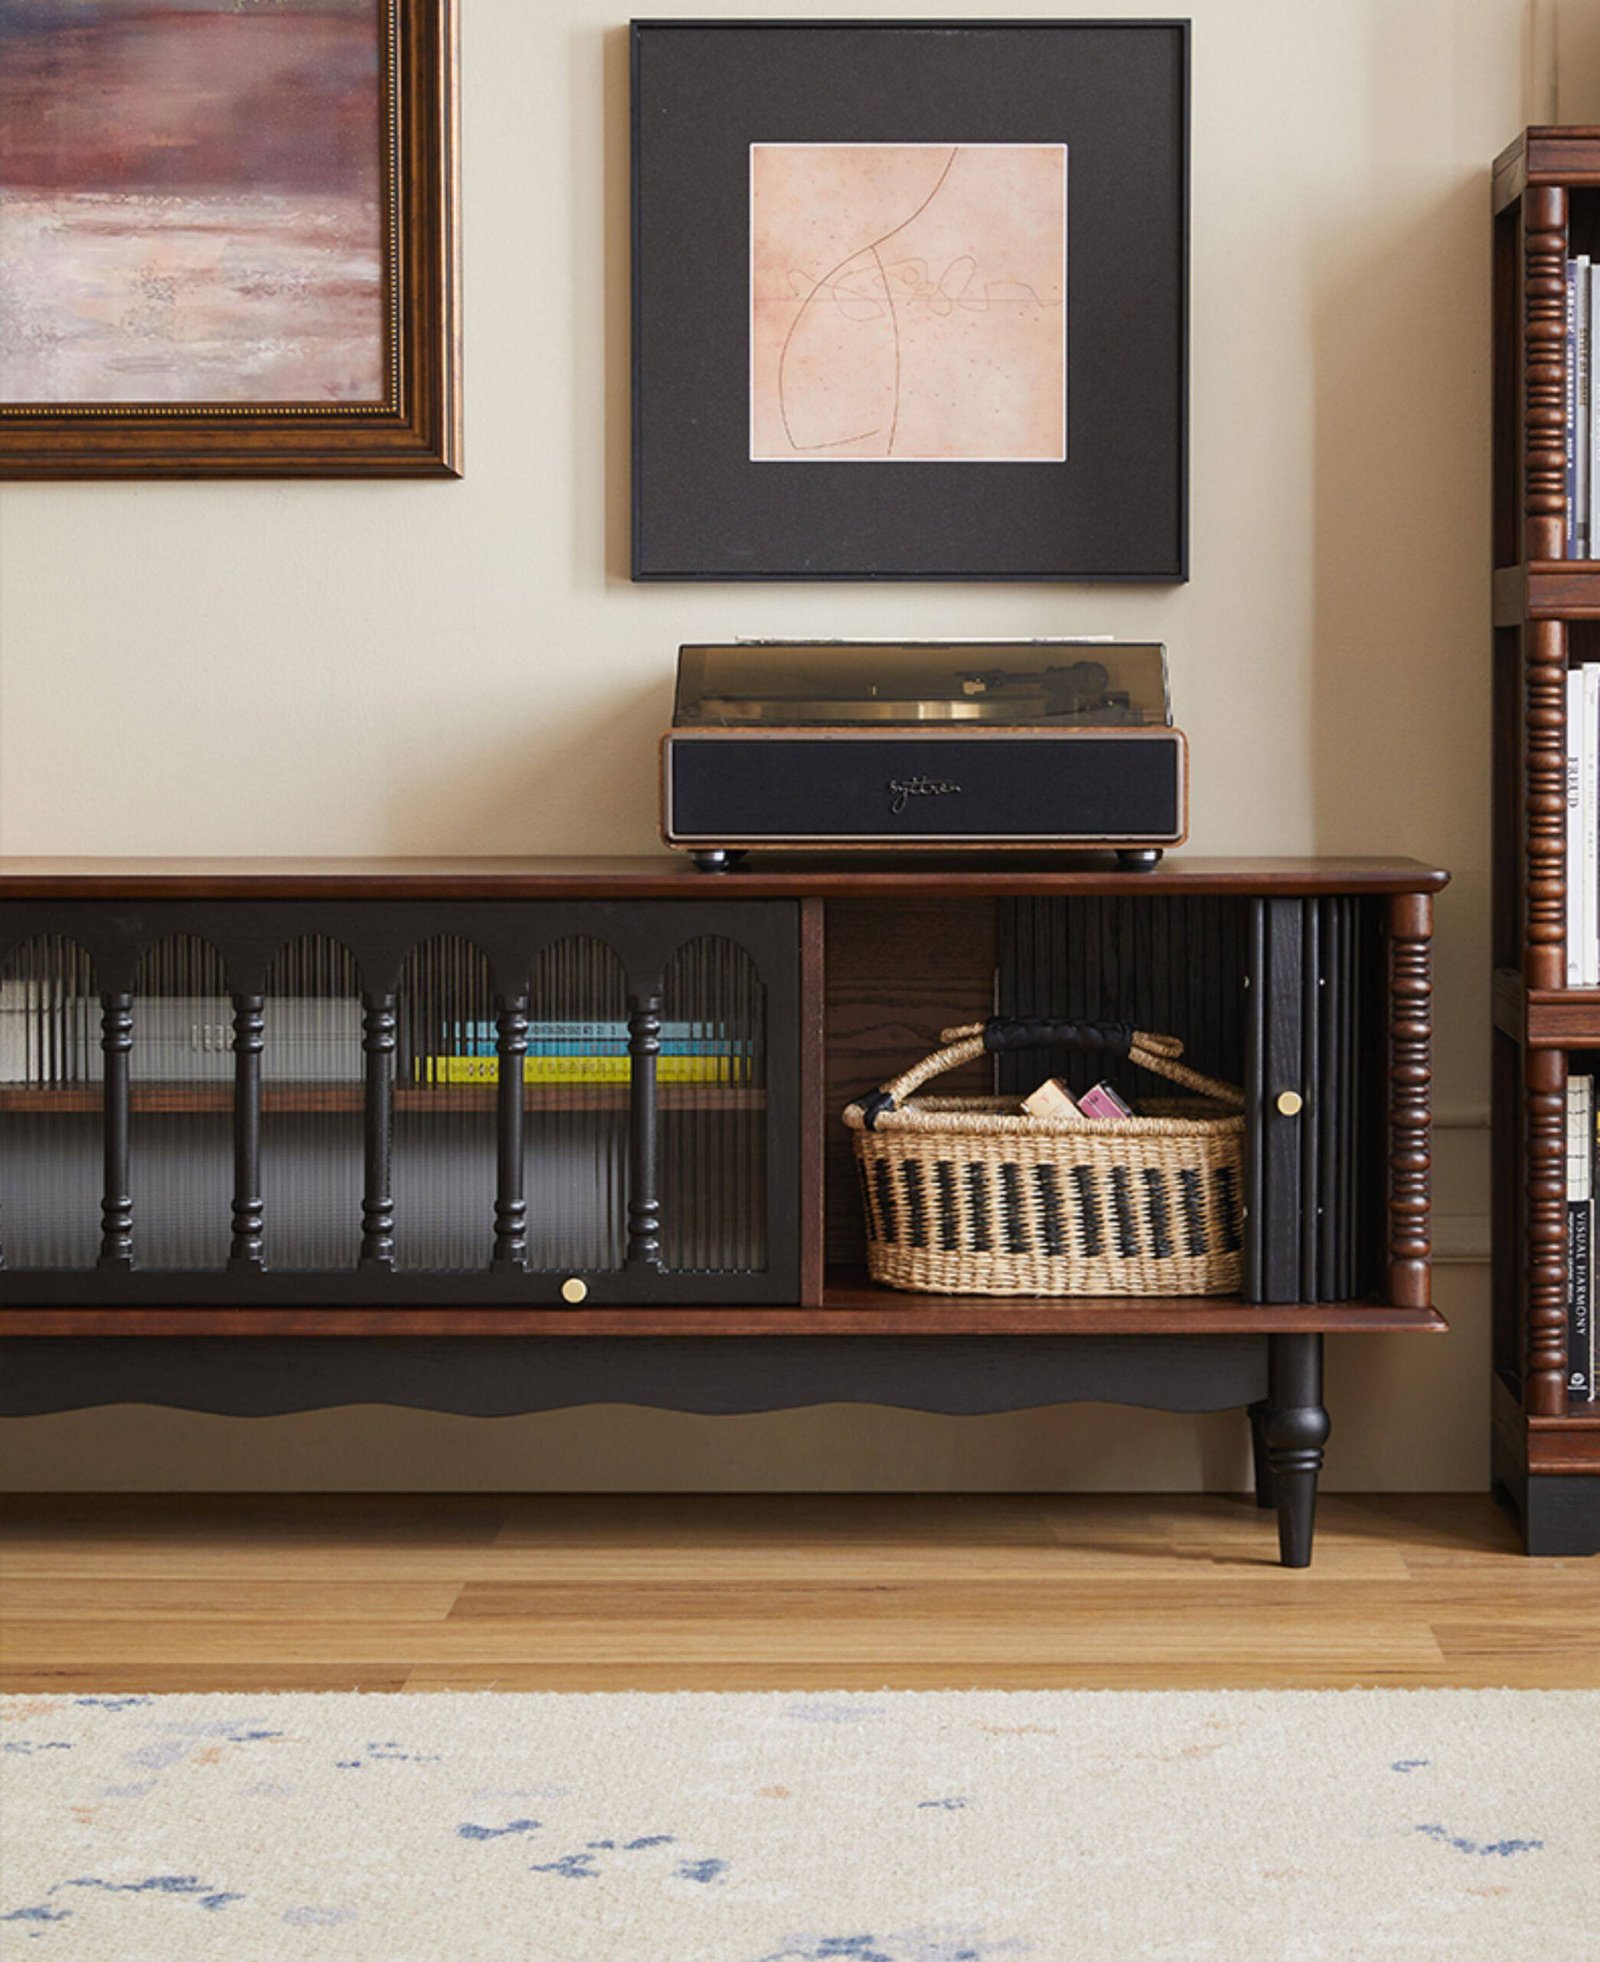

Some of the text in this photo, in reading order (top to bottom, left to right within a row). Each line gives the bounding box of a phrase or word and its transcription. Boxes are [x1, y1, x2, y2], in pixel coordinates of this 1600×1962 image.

[1568, 757, 1579, 808] FREUD
[1576, 1211, 1586, 1336] VISUAL HARMONY
